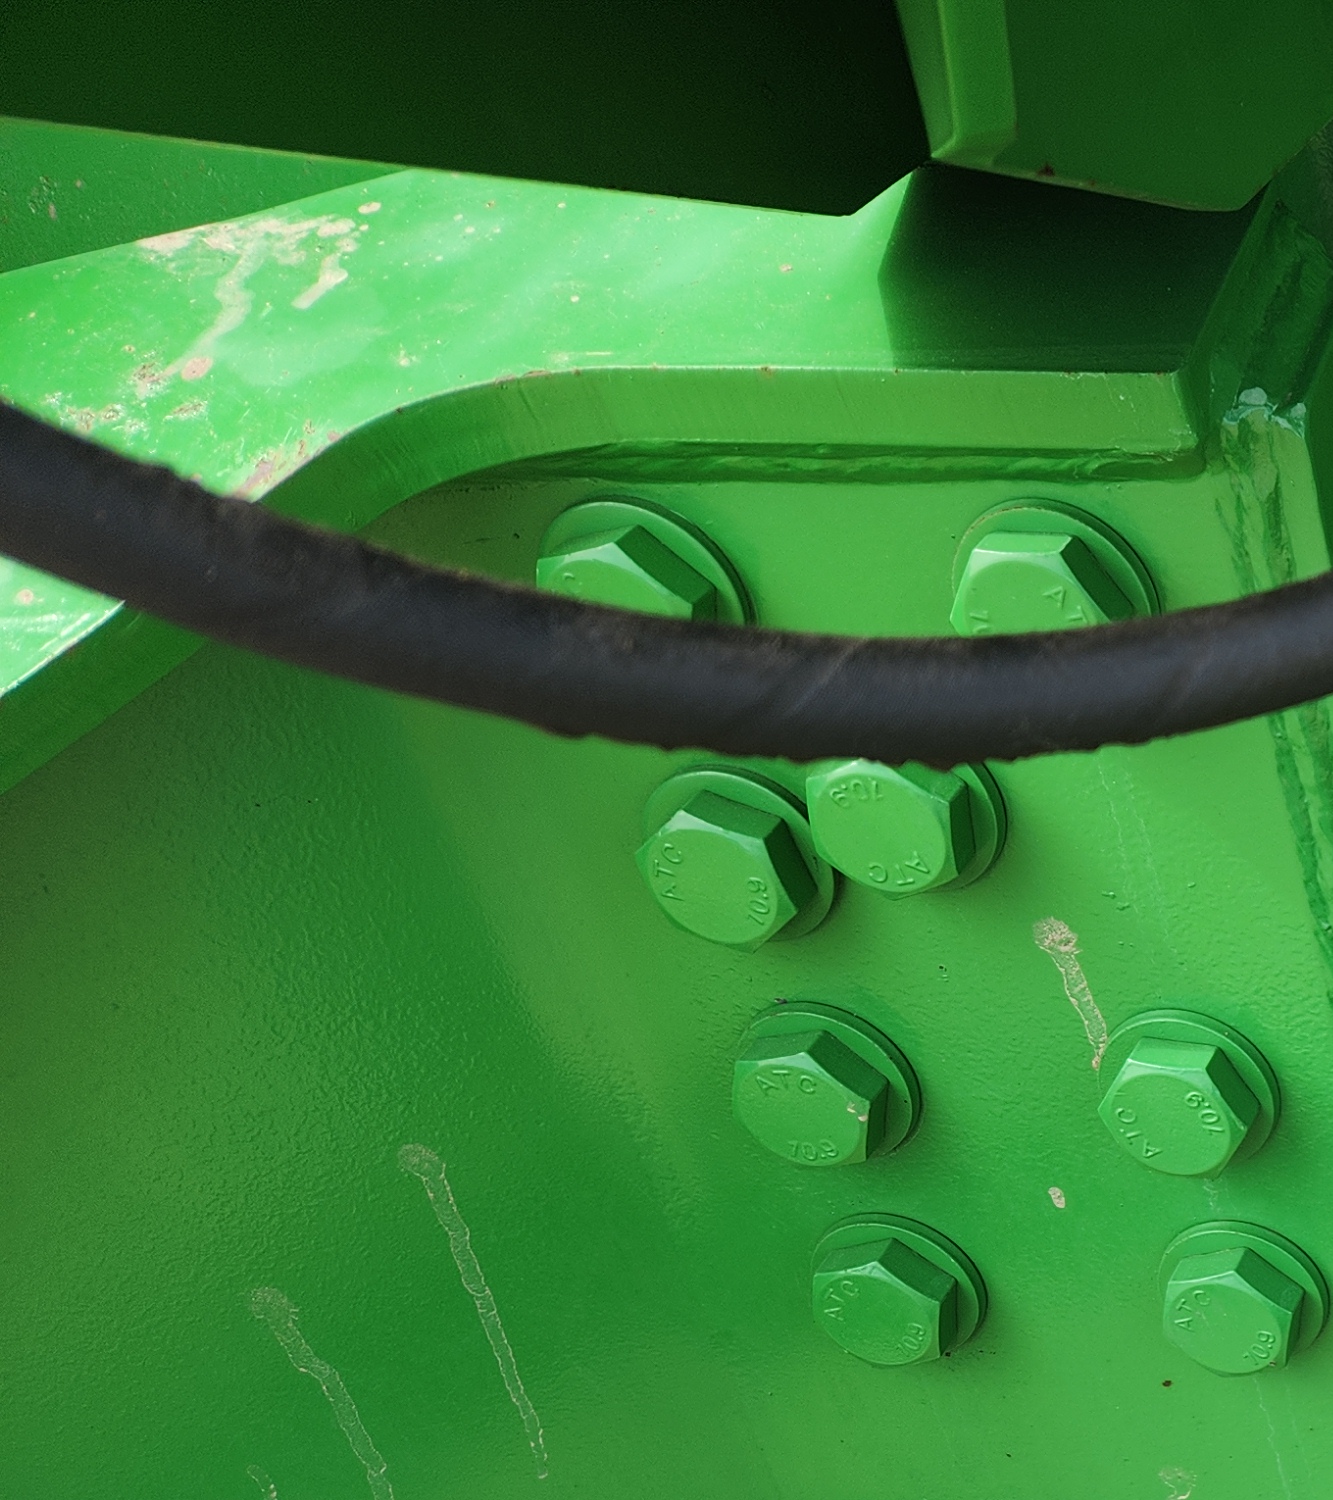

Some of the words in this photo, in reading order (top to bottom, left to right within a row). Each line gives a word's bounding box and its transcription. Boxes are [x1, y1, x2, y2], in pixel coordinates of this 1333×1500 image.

[1042, 586, 1089, 623] AT
[829, 777, 884, 808] 10.9
[653, 843, 684, 902] ATC
[868, 850, 931, 888] ATC
[746, 876, 769, 926] 10.9
[756, 1069, 817, 1097] ATC
[1182, 1091, 1226, 1136] 10.9
[786, 1138, 839, 1162] 10.9
[1115, 1107, 1163, 1160] ATC
[824, 1279, 860, 1322] ATC
[1174, 1290, 1212, 1333] ATC
[897, 1321, 928, 1357] 10.9
[1242, 1330, 1277, 1366] 10.9
